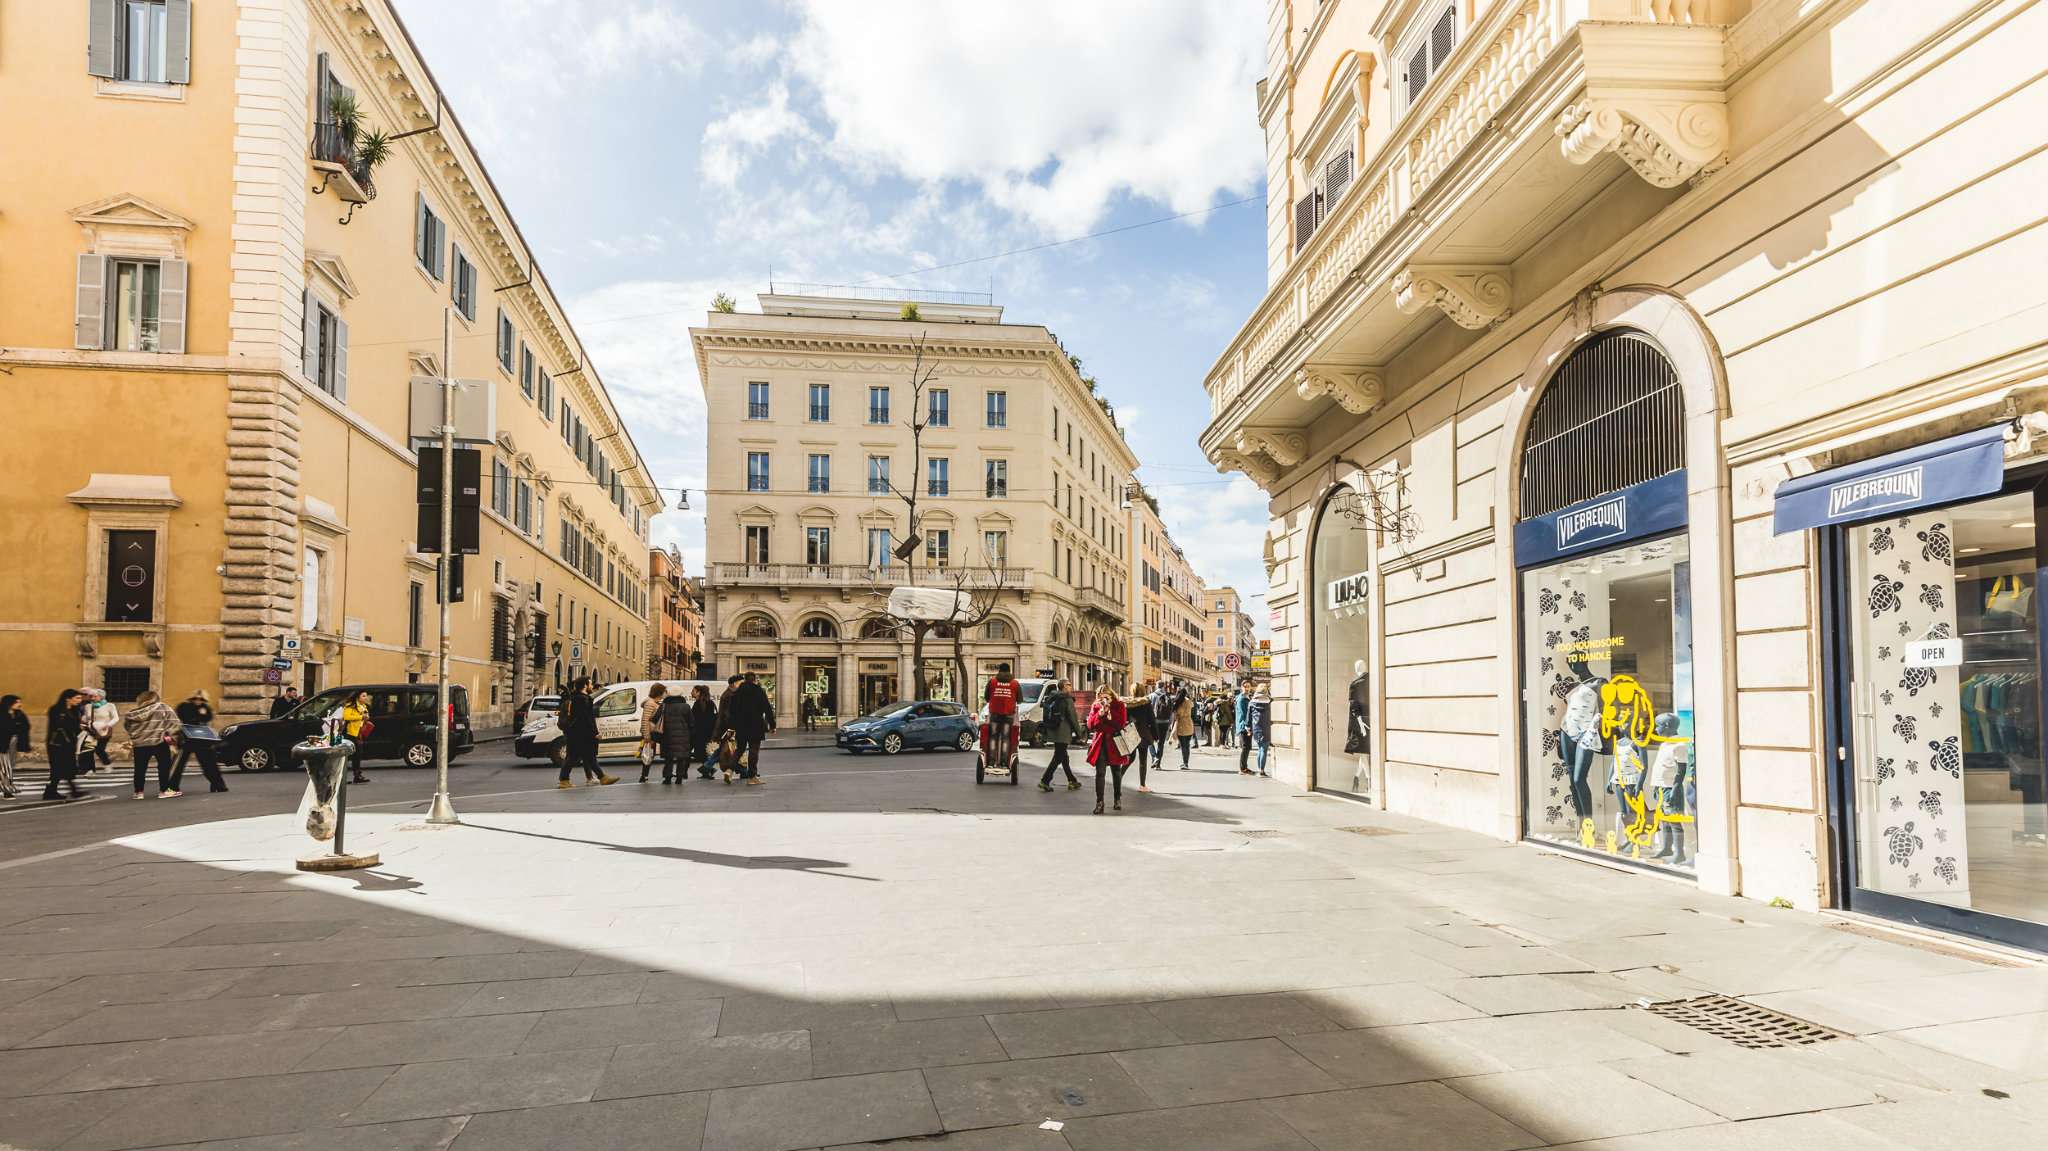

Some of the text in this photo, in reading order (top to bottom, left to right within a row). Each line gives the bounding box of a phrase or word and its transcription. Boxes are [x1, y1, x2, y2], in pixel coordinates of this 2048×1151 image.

[1833, 471, 1918, 514] VILEBREQUIN
[1560, 500, 1623, 546] VILEBREQUIN
[1573, 637, 1624, 650] HOUNDSOME
[1568, 650, 1612, 663] TO HANDLE
[1921, 647, 1945, 660] OPEN
